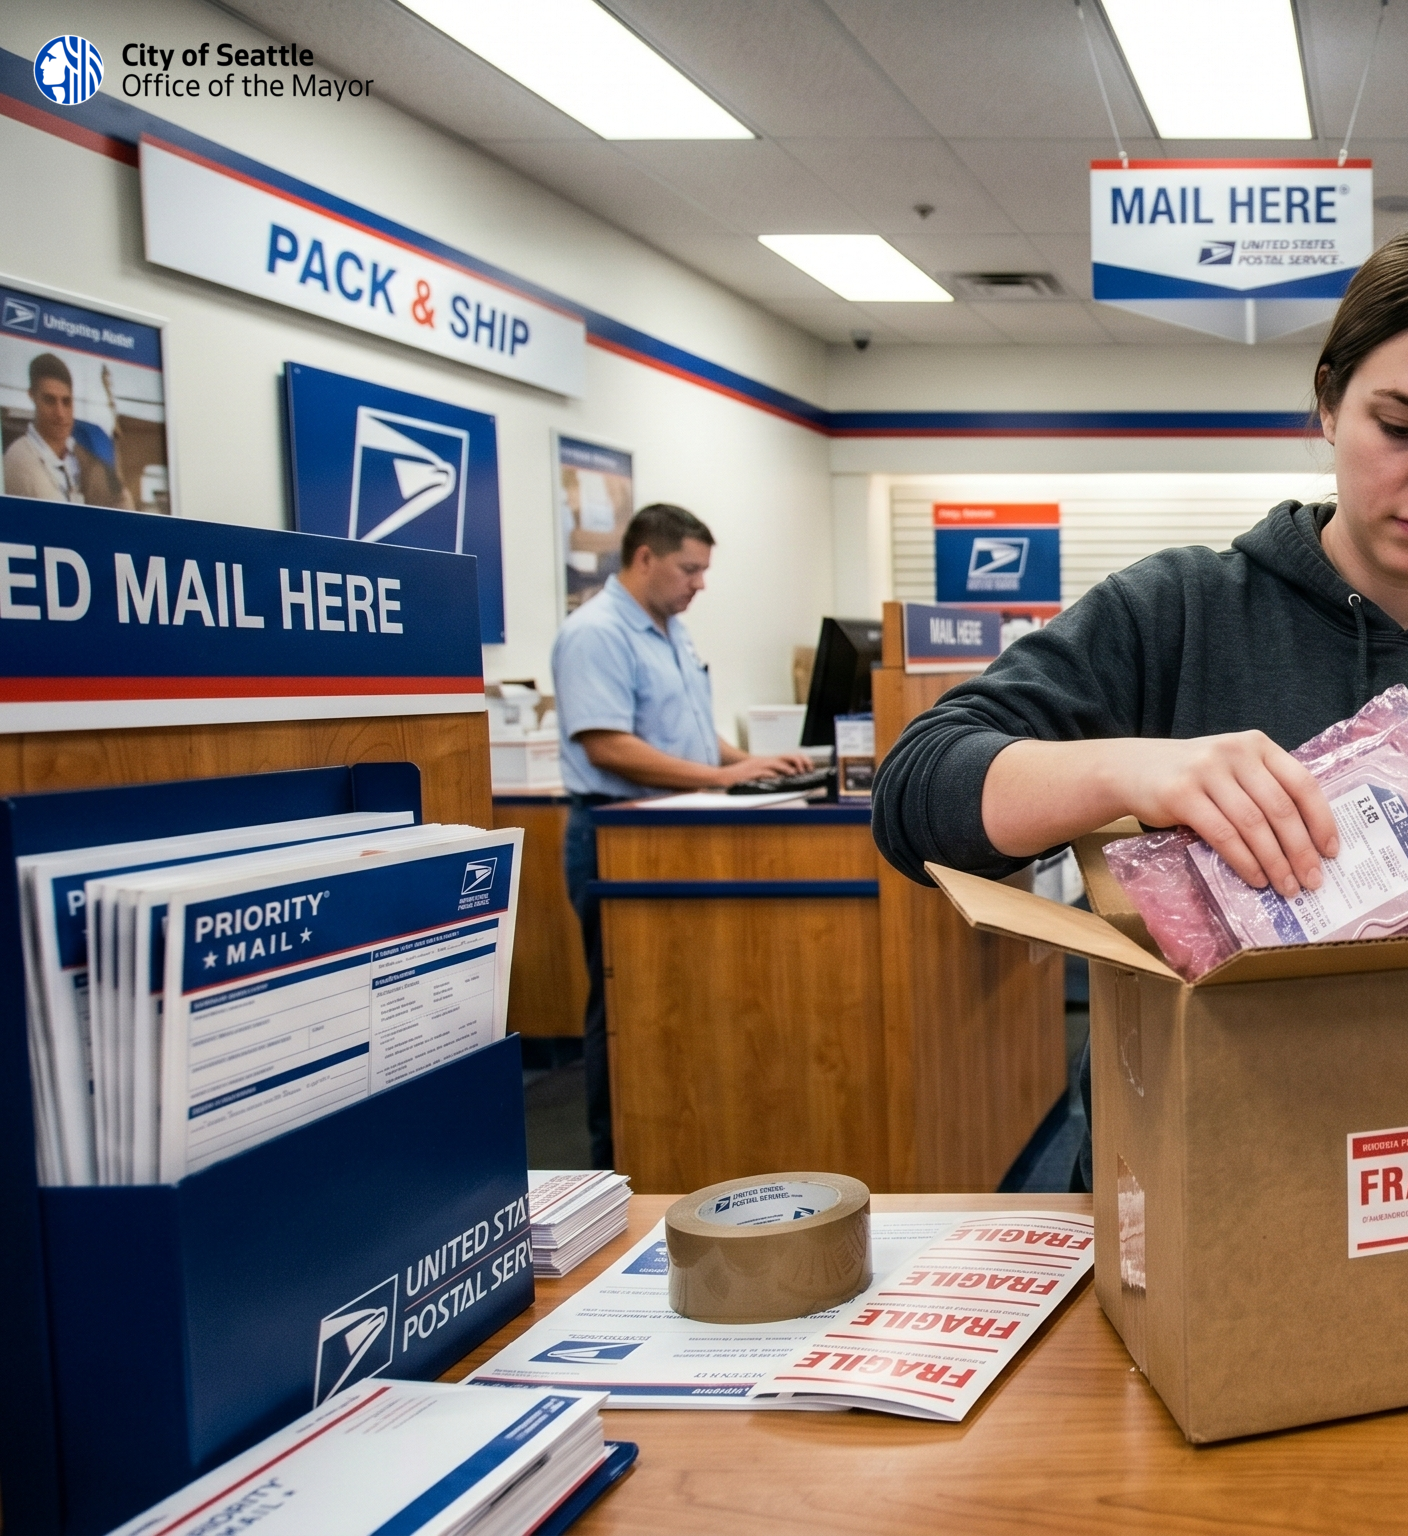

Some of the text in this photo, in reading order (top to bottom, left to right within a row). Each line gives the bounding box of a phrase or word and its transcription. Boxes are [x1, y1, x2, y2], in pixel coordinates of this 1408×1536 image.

[1111, 186, 1214, 225] MAIL
[1238, 255, 1284, 265] POSTAL
[1241, 239, 1290, 250] UNITED
[267, 223, 529, 356] PACK & SHIP
[0, 542, 404, 634] ED MAIL HERE
[930, 617, 956, 645] MAIL
[195, 891, 324, 943] PRIORITY
[226, 931, 293, 966] MAIL
[406, 1193, 529, 1297] UNITED STA
[948, 1228, 1094, 1251] FRAGILE
[906, 1271, 1059, 1296] FRAGILE
[403, 1271, 487, 1352] POSTAL
[851, 1308, 1021, 1341] FRAGILE
[794, 1351, 977, 1389] FRAGILE
